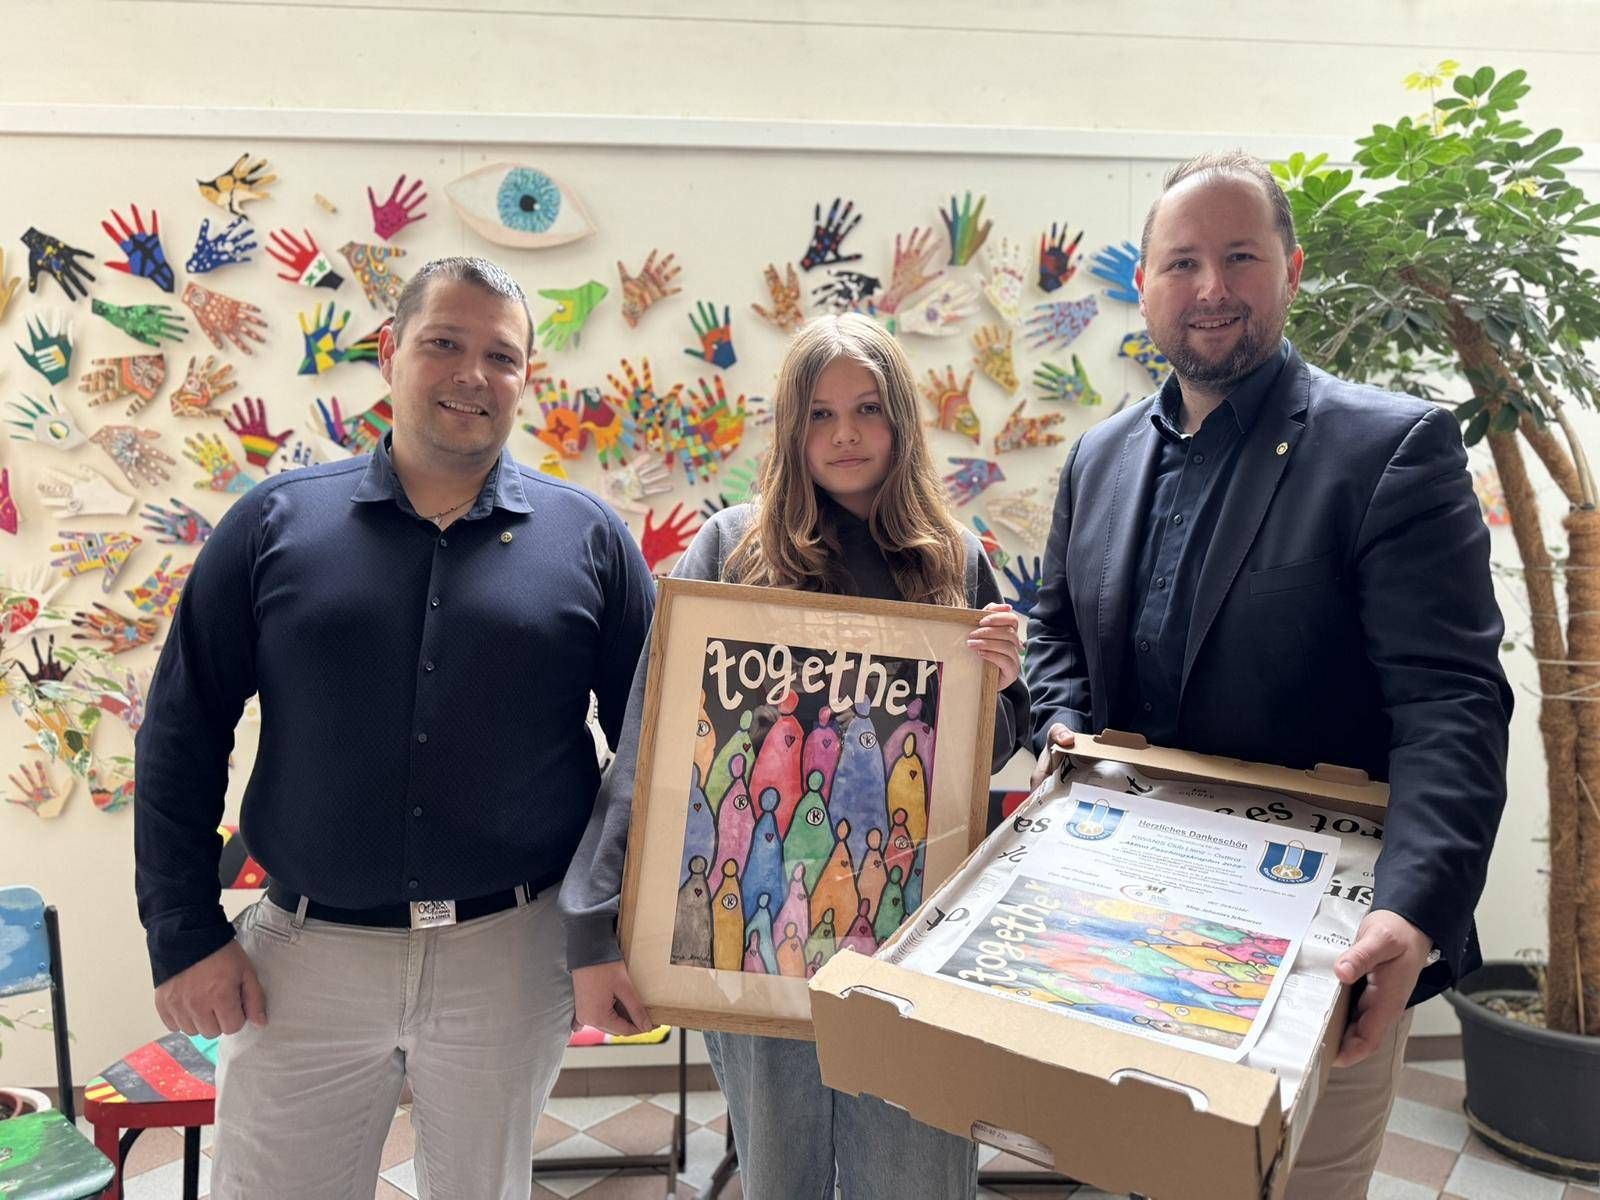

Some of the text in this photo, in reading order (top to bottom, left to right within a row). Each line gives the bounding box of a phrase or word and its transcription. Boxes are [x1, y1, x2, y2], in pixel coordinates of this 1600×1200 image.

[705, 639, 940, 715] together
[1138, 819, 1187, 836] Herzliches
[1189, 830, 1249, 850] Dankeschön
[958, 880, 1062, 982] together
